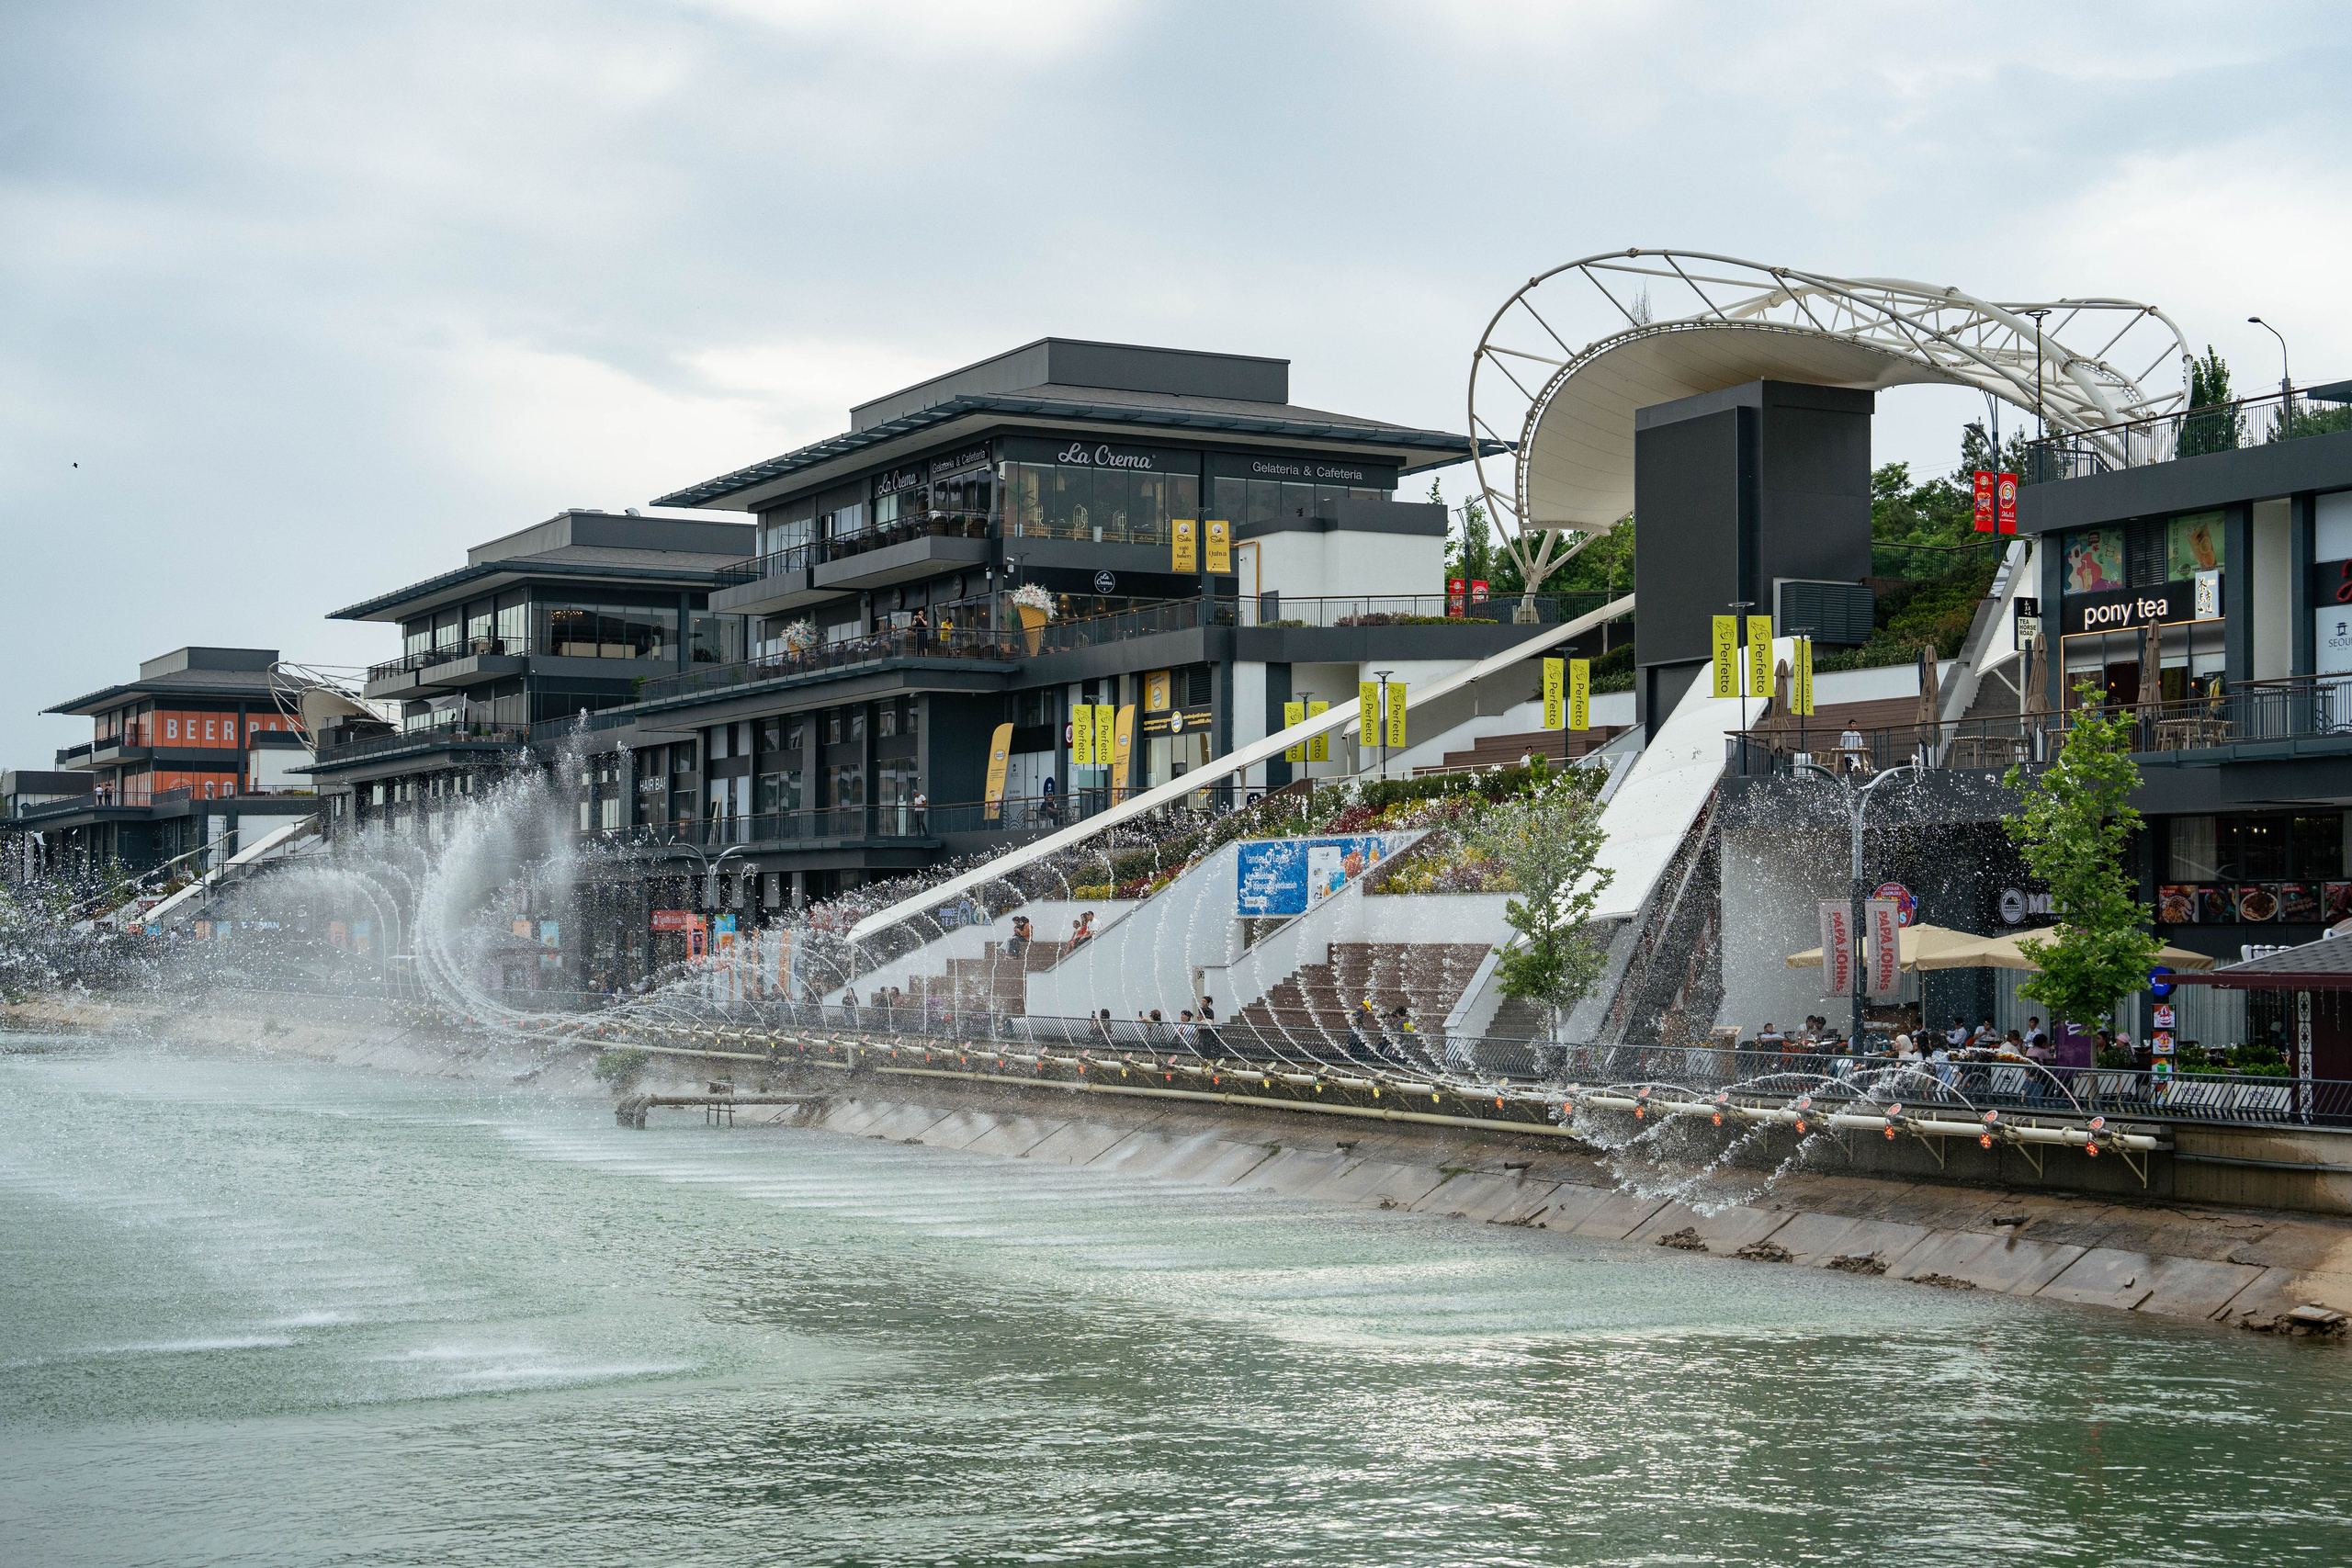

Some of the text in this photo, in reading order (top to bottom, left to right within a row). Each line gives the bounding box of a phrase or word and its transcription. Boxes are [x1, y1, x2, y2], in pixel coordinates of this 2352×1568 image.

[932, 448, 986, 474] Gelateria & Cafeteria
[1057, 443, 1153, 468] La Crema
[1252, 461, 1363, 480] Gelateria & Cafeteria
[878, 469, 918, 494] La Crema
[2084, 597, 2169, 631] pony tea
[1721, 643, 1731, 694] Perfetto
[1755, 643, 1766, 694] Perfetto
[1549, 682, 1558, 726] Perfetto
[1575, 682, 1585, 727] Perfetto
[166, 718, 234, 740] BEER
[1365, 703, 1374, 743] Perfetto
[1392, 704, 1401, 744] Perfetto
[1078, 724, 1087, 761] Perfetto
[1101, 724, 1109, 761] Perfetto
[639, 778, 654, 793] HAIR
[1832, 911, 1848, 945] PAPA
[1878, 910, 1894, 944] PAPA
